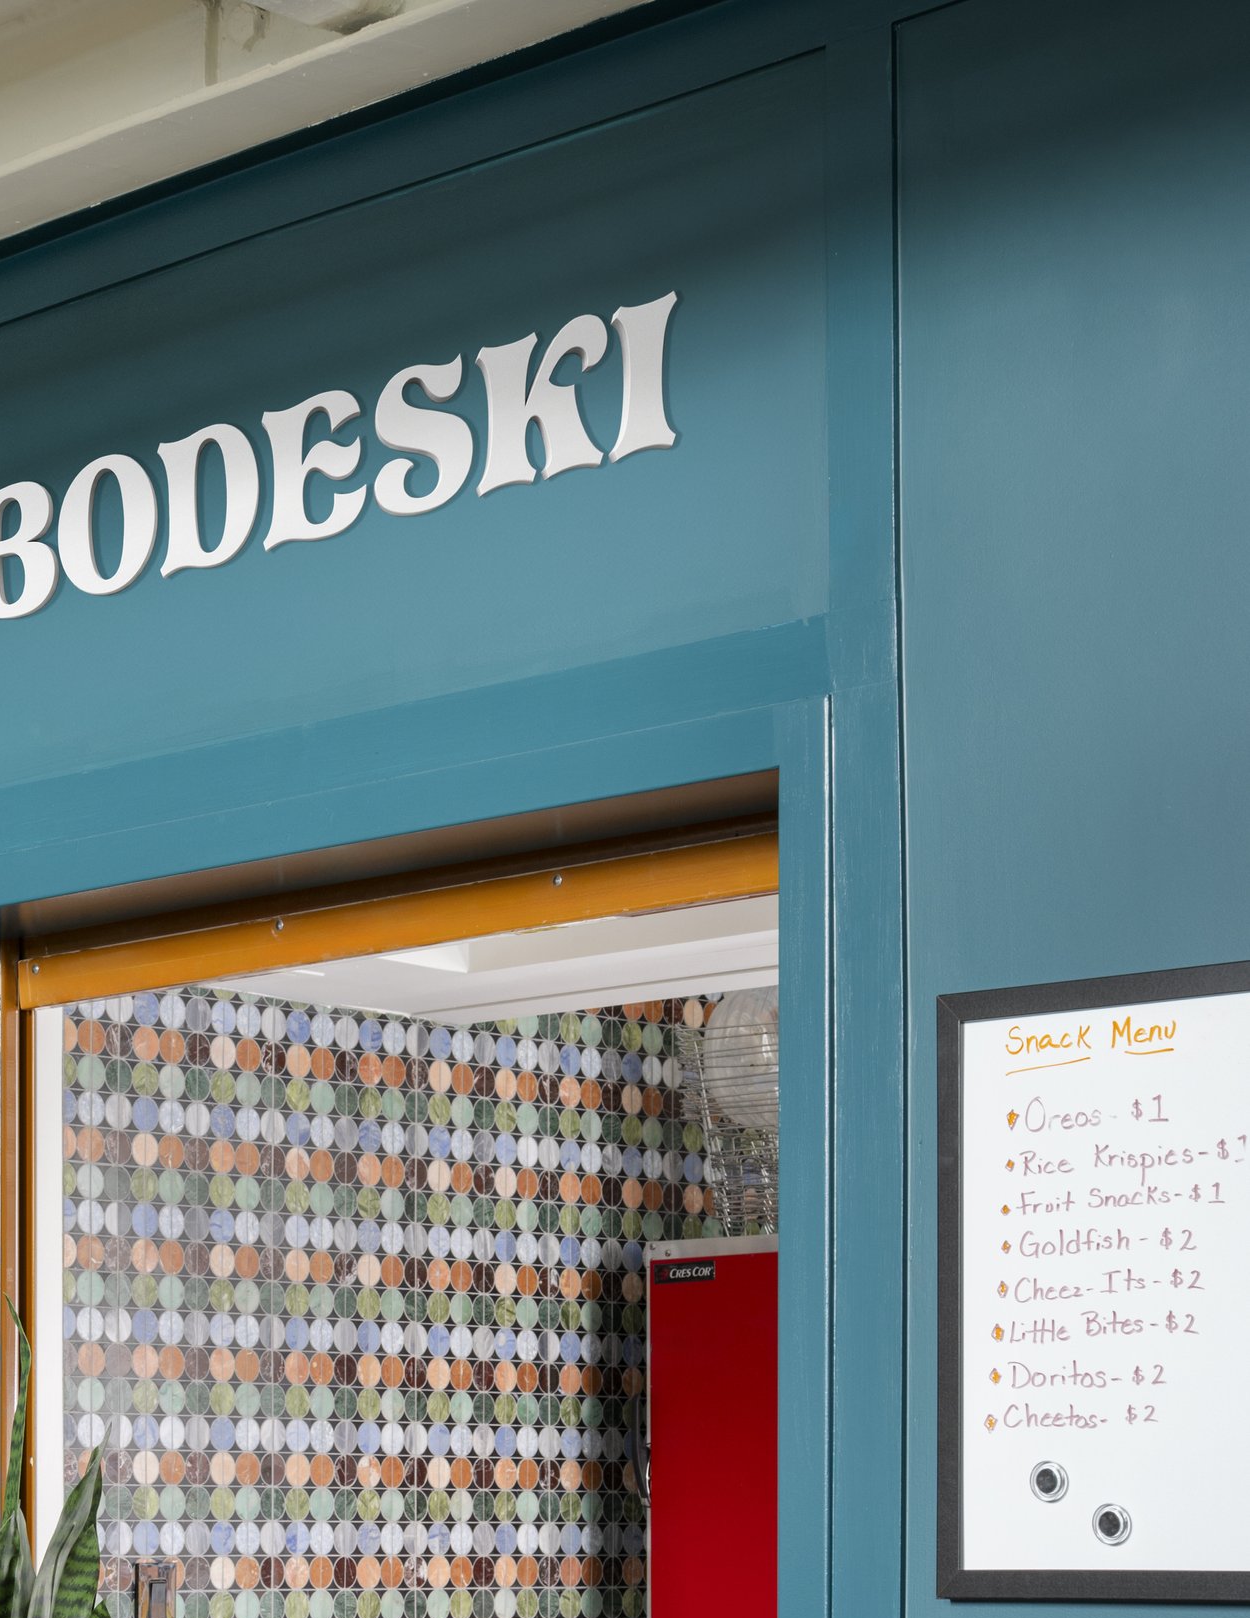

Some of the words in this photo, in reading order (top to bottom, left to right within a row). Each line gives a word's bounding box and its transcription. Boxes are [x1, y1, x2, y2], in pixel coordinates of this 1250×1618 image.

[1005, 1024, 1092, 1056] Snack
[1110, 1015, 1177, 1049] Menu
[1019, 1150, 1074, 1177] Rice
[1016, 1190, 1076, 1216] Fruit
[1019, 1228, 1130, 1259] Goldfish
[1009, 1317, 1071, 1344] Little
